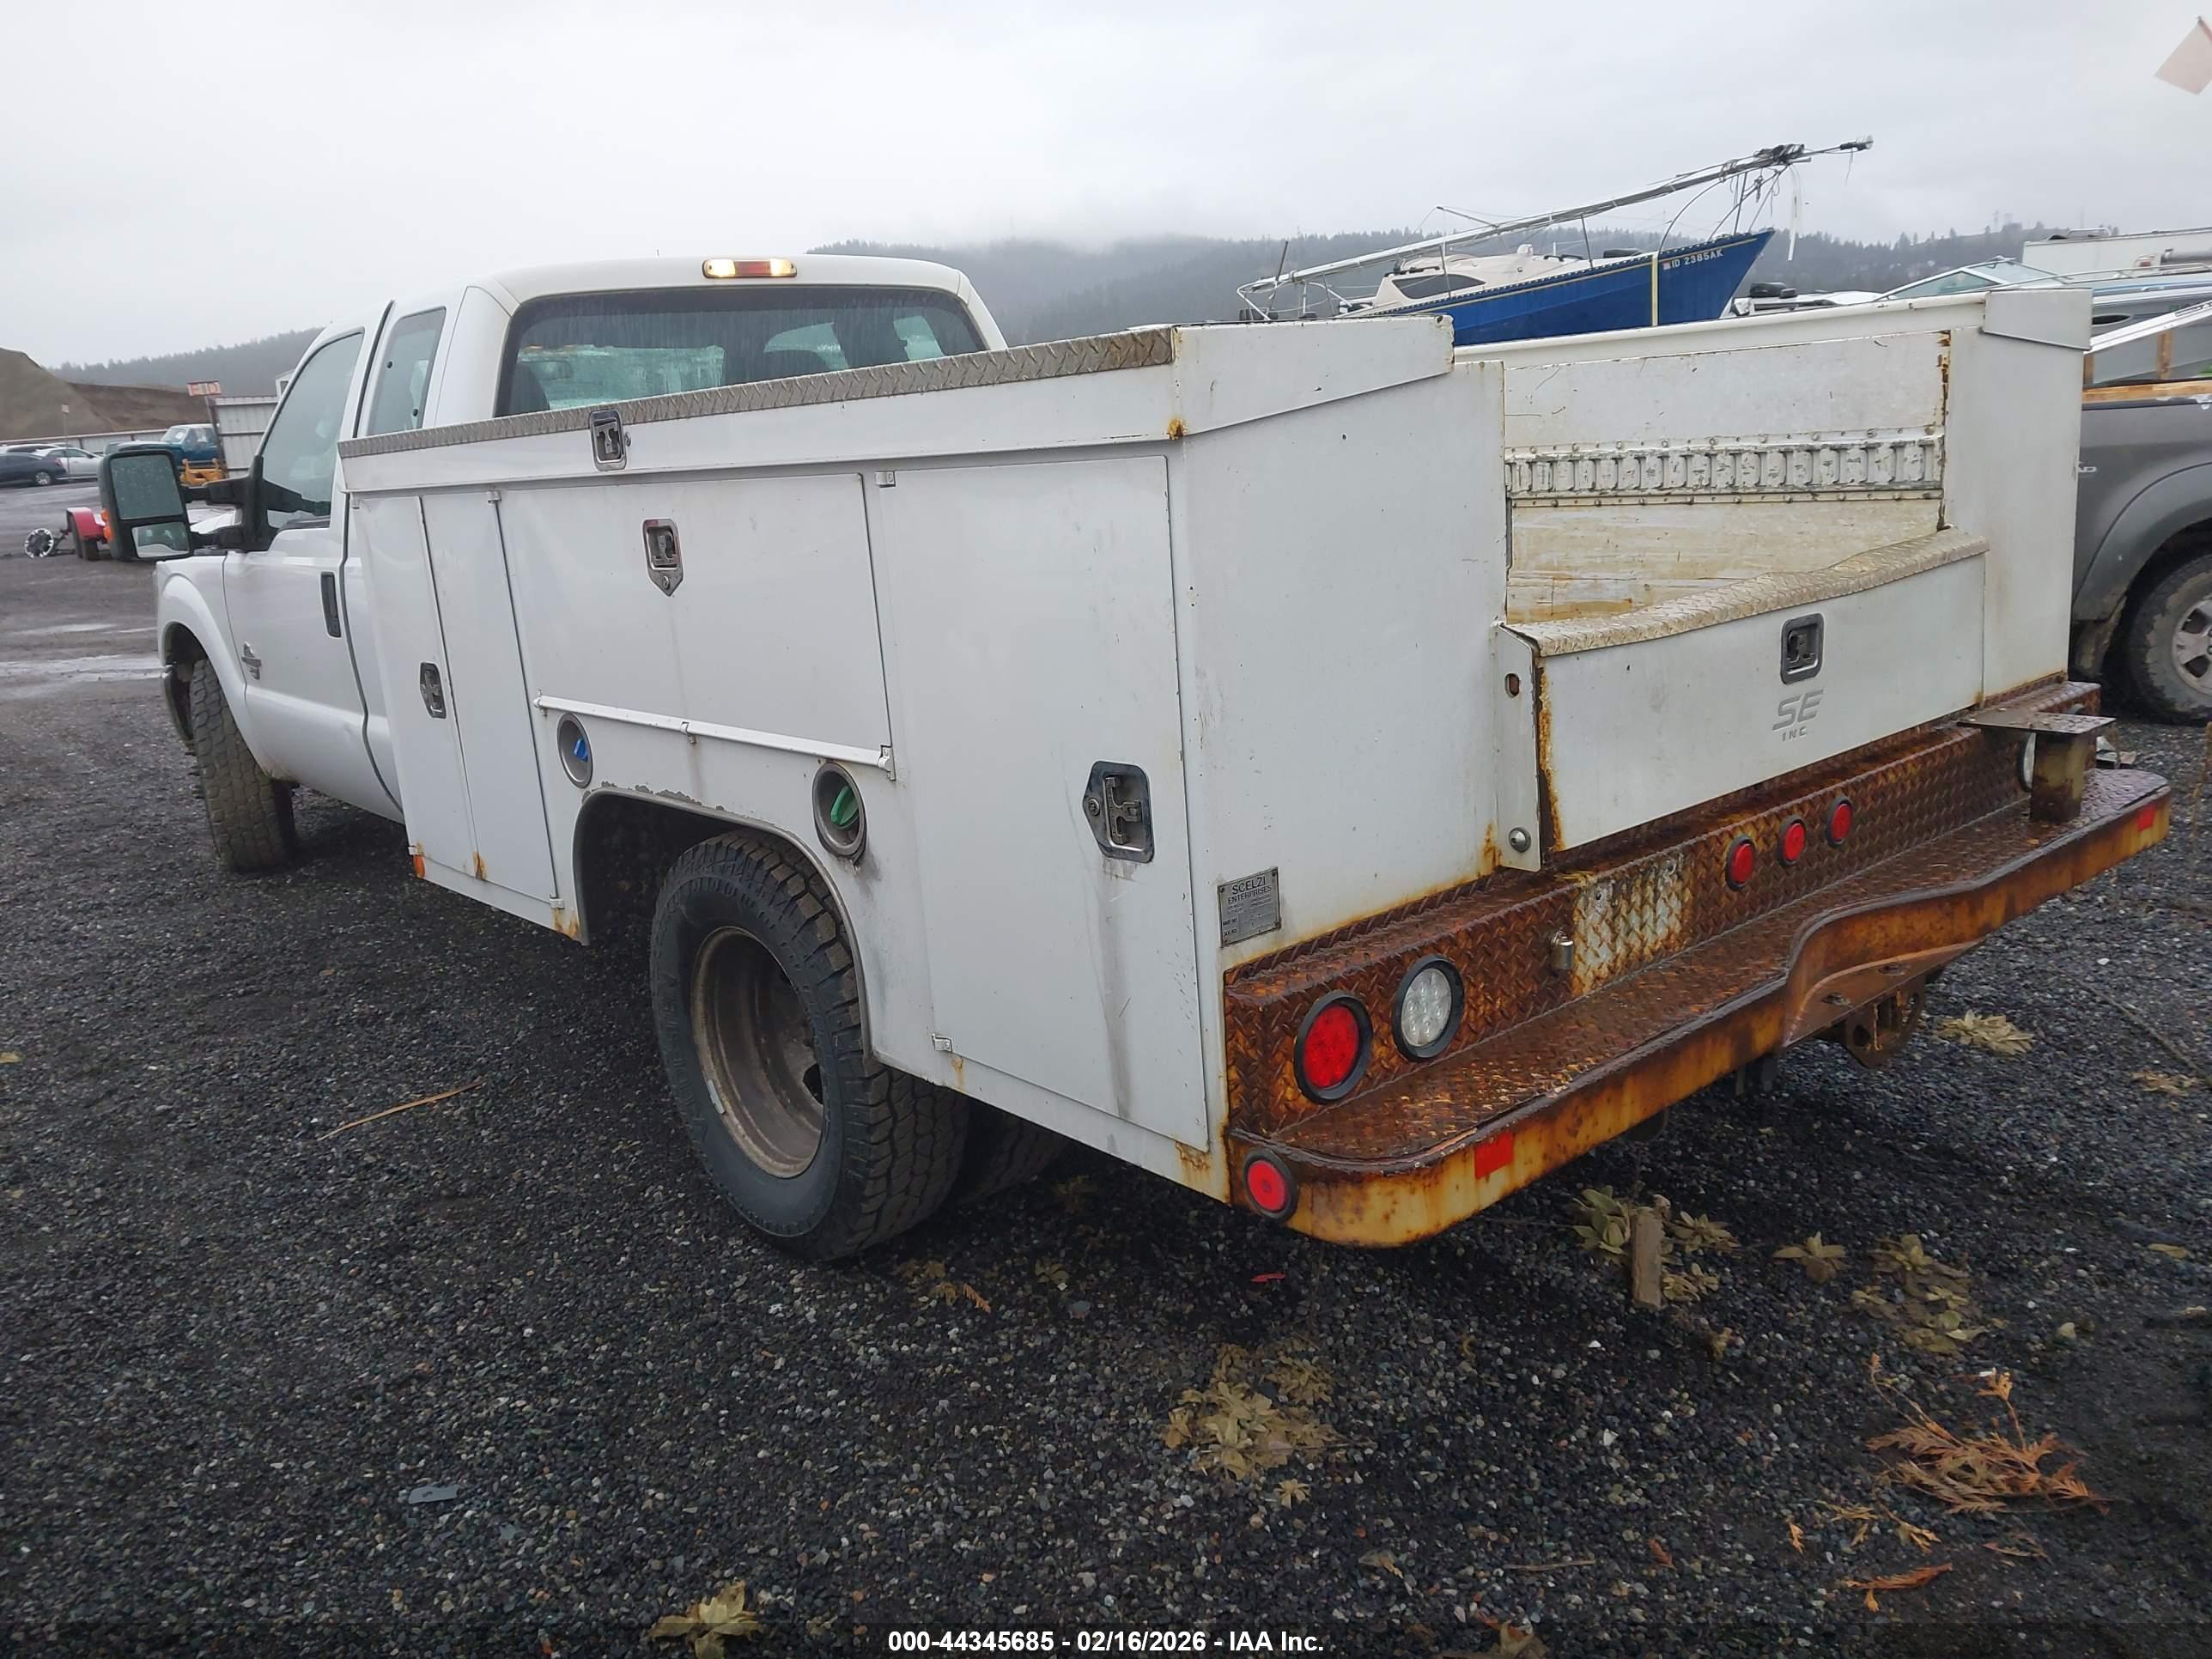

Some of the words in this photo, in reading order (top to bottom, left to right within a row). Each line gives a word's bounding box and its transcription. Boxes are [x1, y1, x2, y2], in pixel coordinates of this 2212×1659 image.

[1671, 258, 1680, 268] ID
[1228, 885, 1272, 904] ENTERPRISES
[1231, 877, 1266, 895] SCELZI
